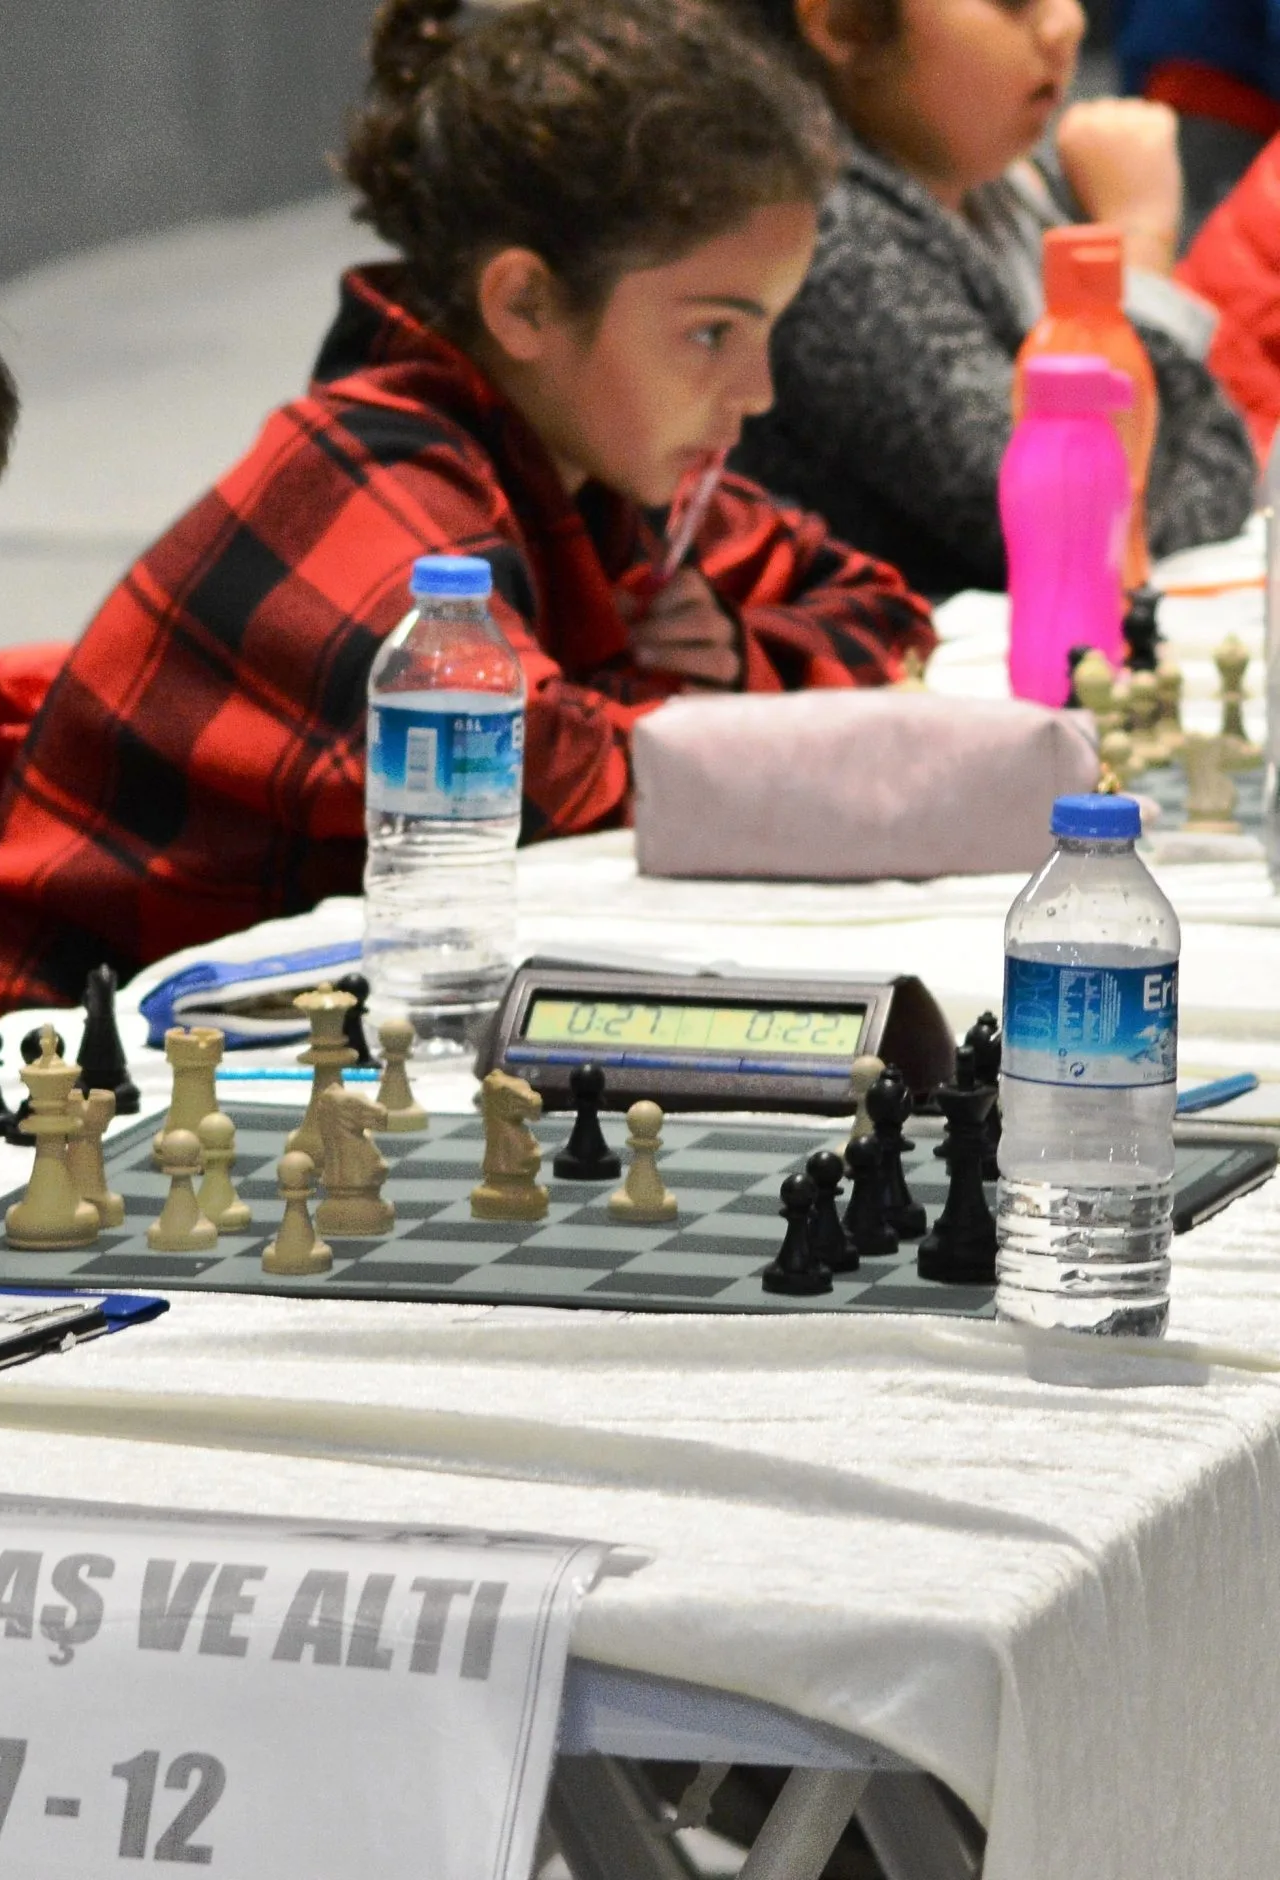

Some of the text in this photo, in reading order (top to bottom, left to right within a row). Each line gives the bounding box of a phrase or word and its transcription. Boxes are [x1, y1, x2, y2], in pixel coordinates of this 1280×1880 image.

[567, 1003, 662, 1036] 0:27
[136, 1558, 268, 1658] VE
[271, 1569, 508, 1681] ALTI
[112, 1750, 227, 1865] 12
